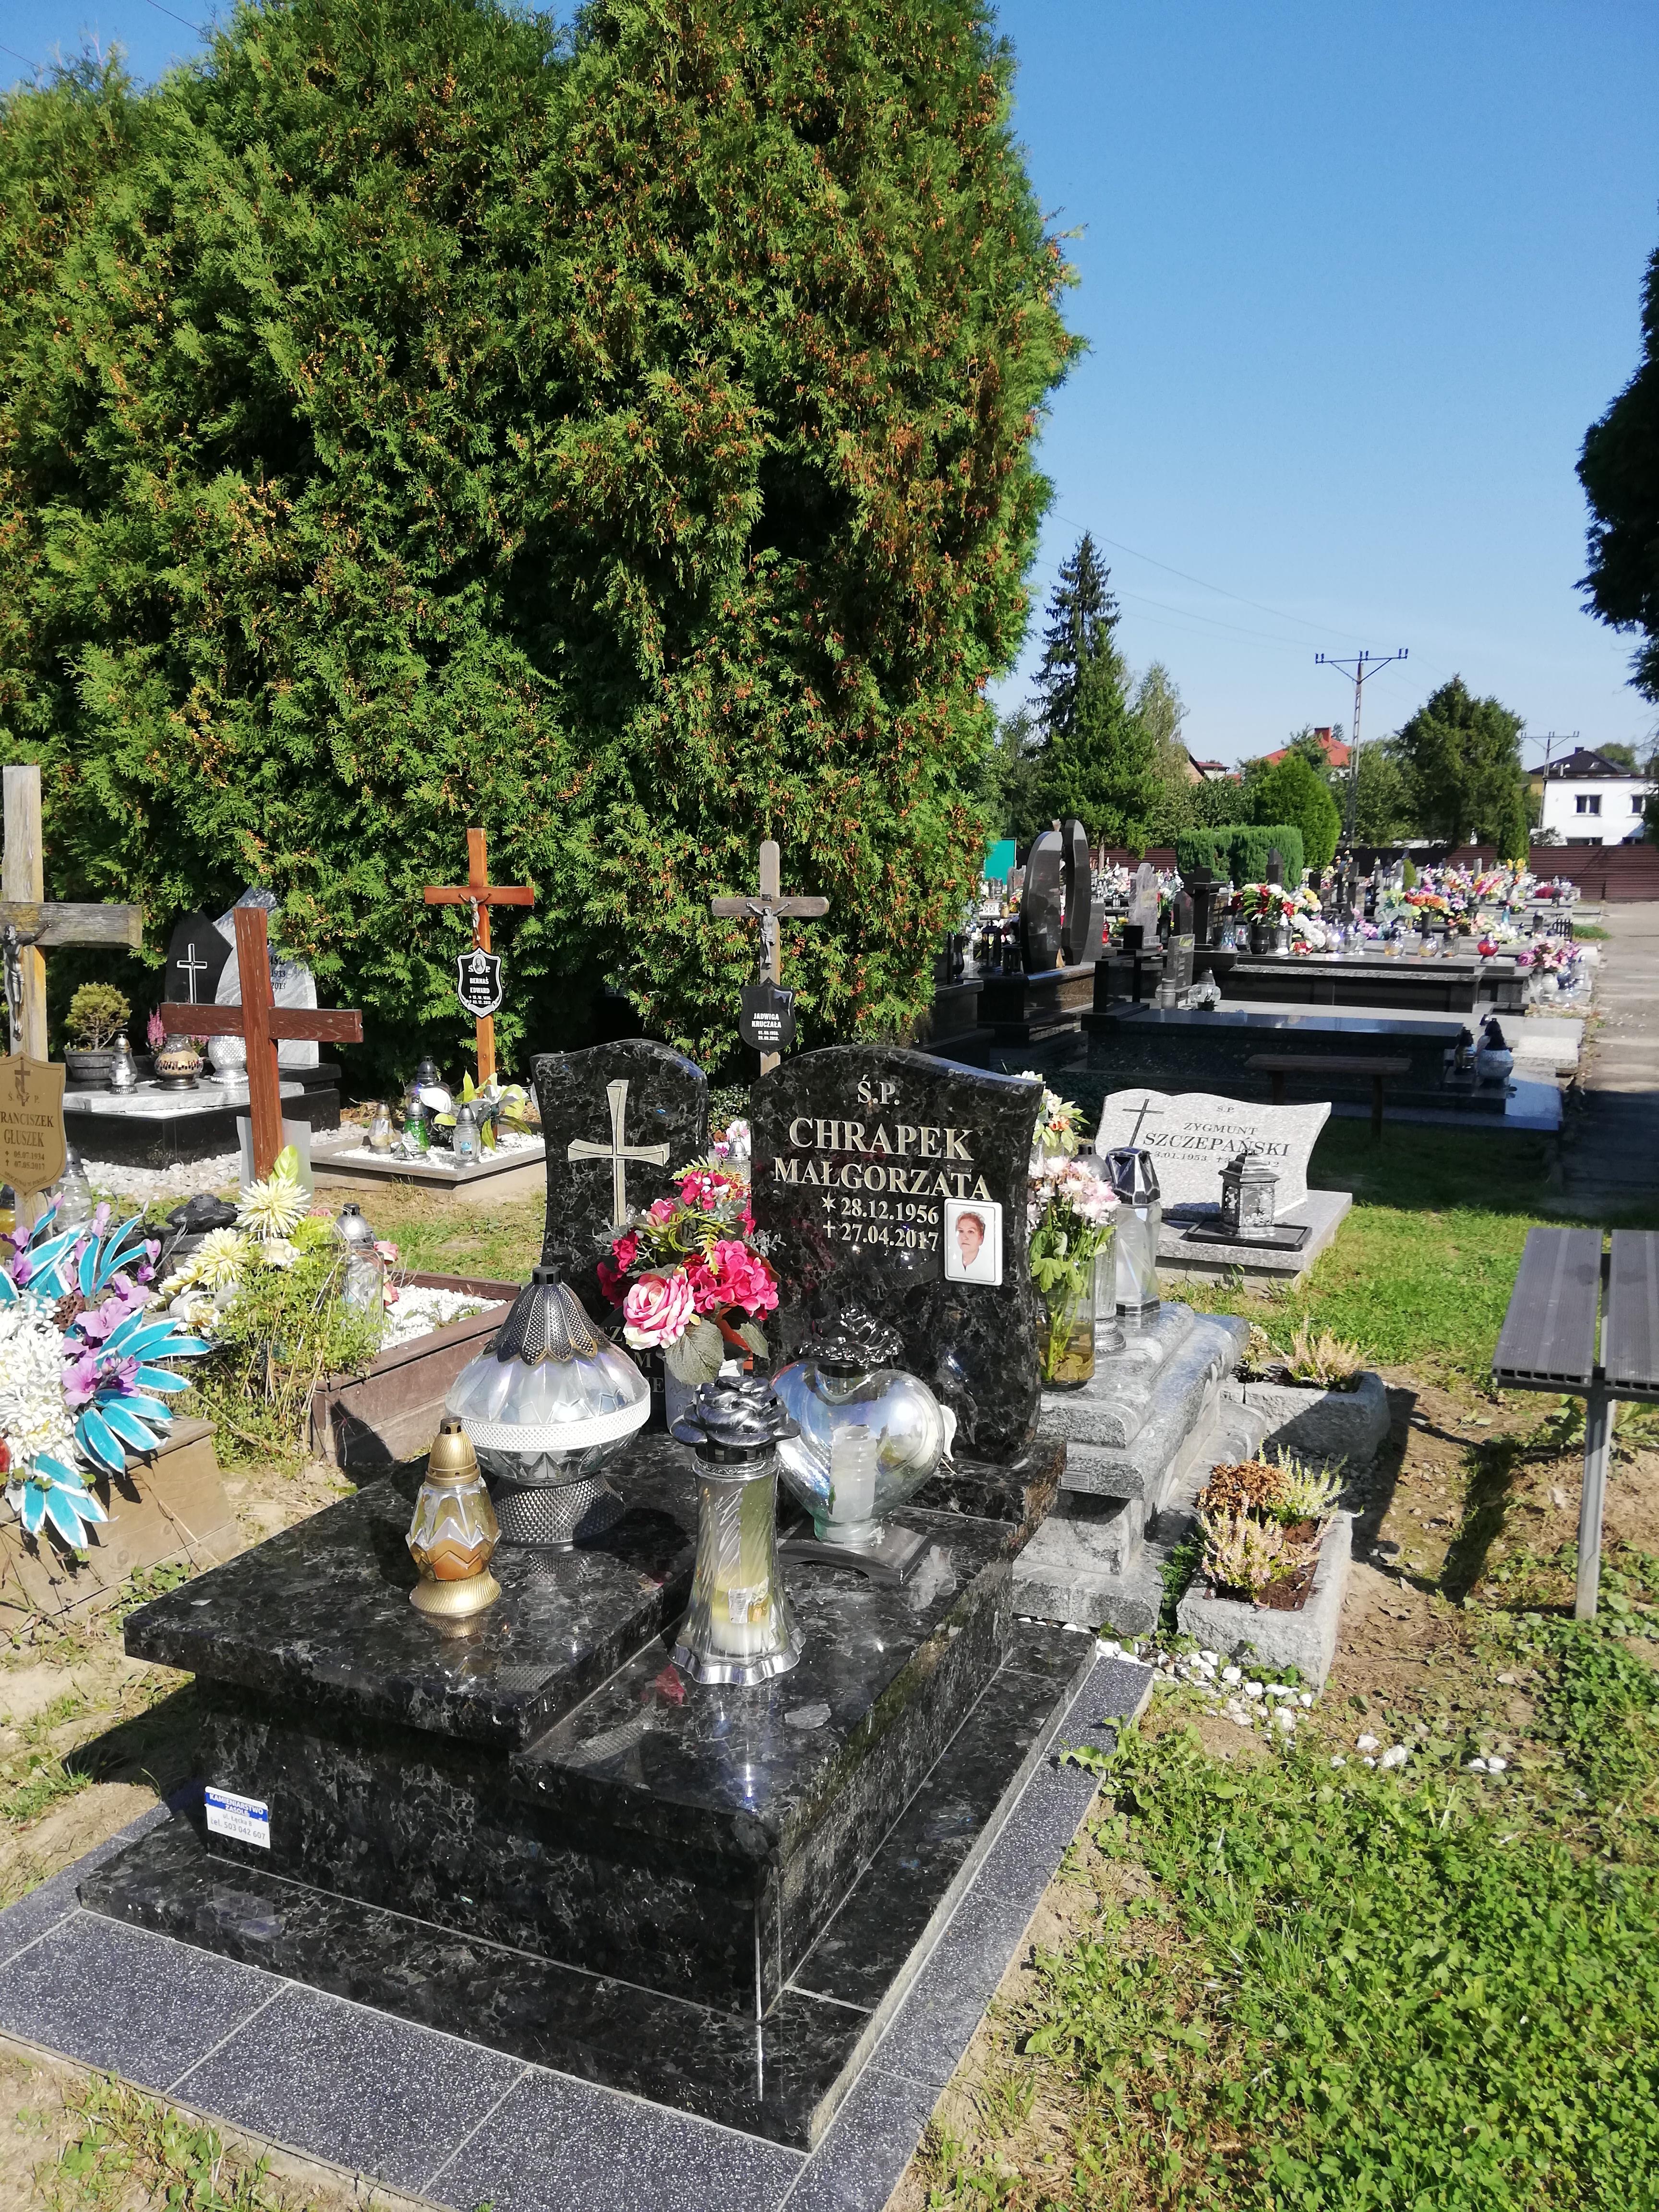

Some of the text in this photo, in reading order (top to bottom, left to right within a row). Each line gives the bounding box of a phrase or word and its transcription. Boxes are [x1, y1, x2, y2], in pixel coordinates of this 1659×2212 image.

[271, 969, 286, 977] 1933
[469, 976, 489, 985] BERNAŚ
[857, 1074, 900, 1106] Ś.P.
[789, 1117, 974, 1161] CHRAPEK
[1183, 1122, 1258, 1135] ZYGMUNT
[1142, 1132, 1292, 1156] SZCZEPAŃSKI
[773, 1157, 994, 1201] MAŁGORZATA
[842, 1197, 939, 1224] 28.12.1956
[842, 1222, 938, 1251] 27.04.2017
[209, 1793, 264, 1815] KAMIENIARSTWO
[210, 1817, 265, 1839] tel. 503 042 607
